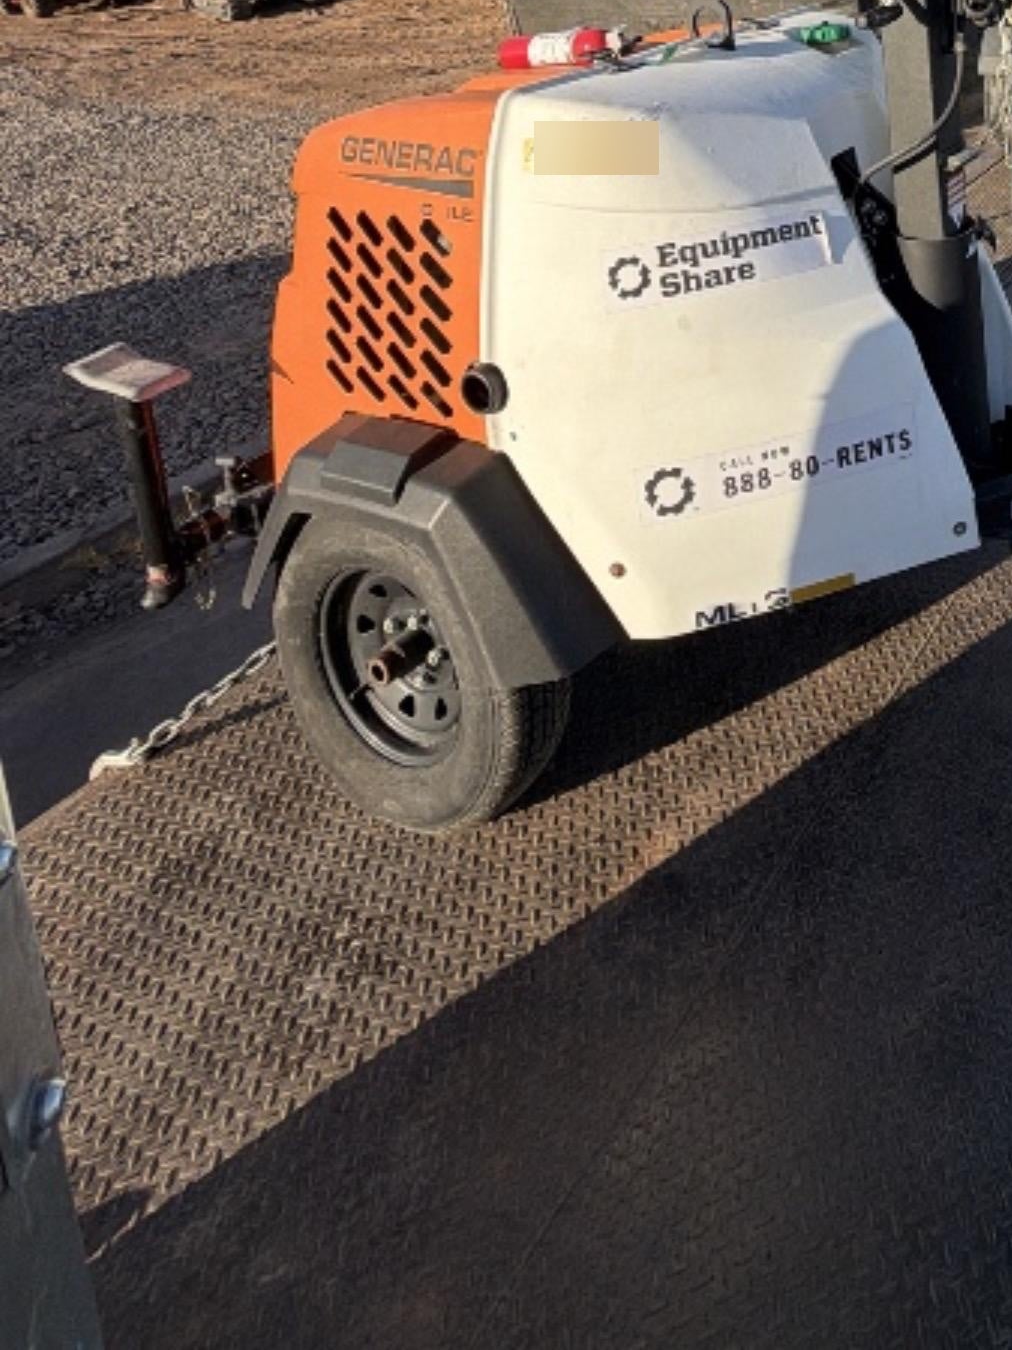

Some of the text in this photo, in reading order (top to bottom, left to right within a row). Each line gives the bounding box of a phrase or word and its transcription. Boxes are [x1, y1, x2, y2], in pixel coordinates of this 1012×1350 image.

[340, 135, 476, 177] GENERAC
[656, 215, 823, 268] Equipment
[659, 262, 756, 298] Share
